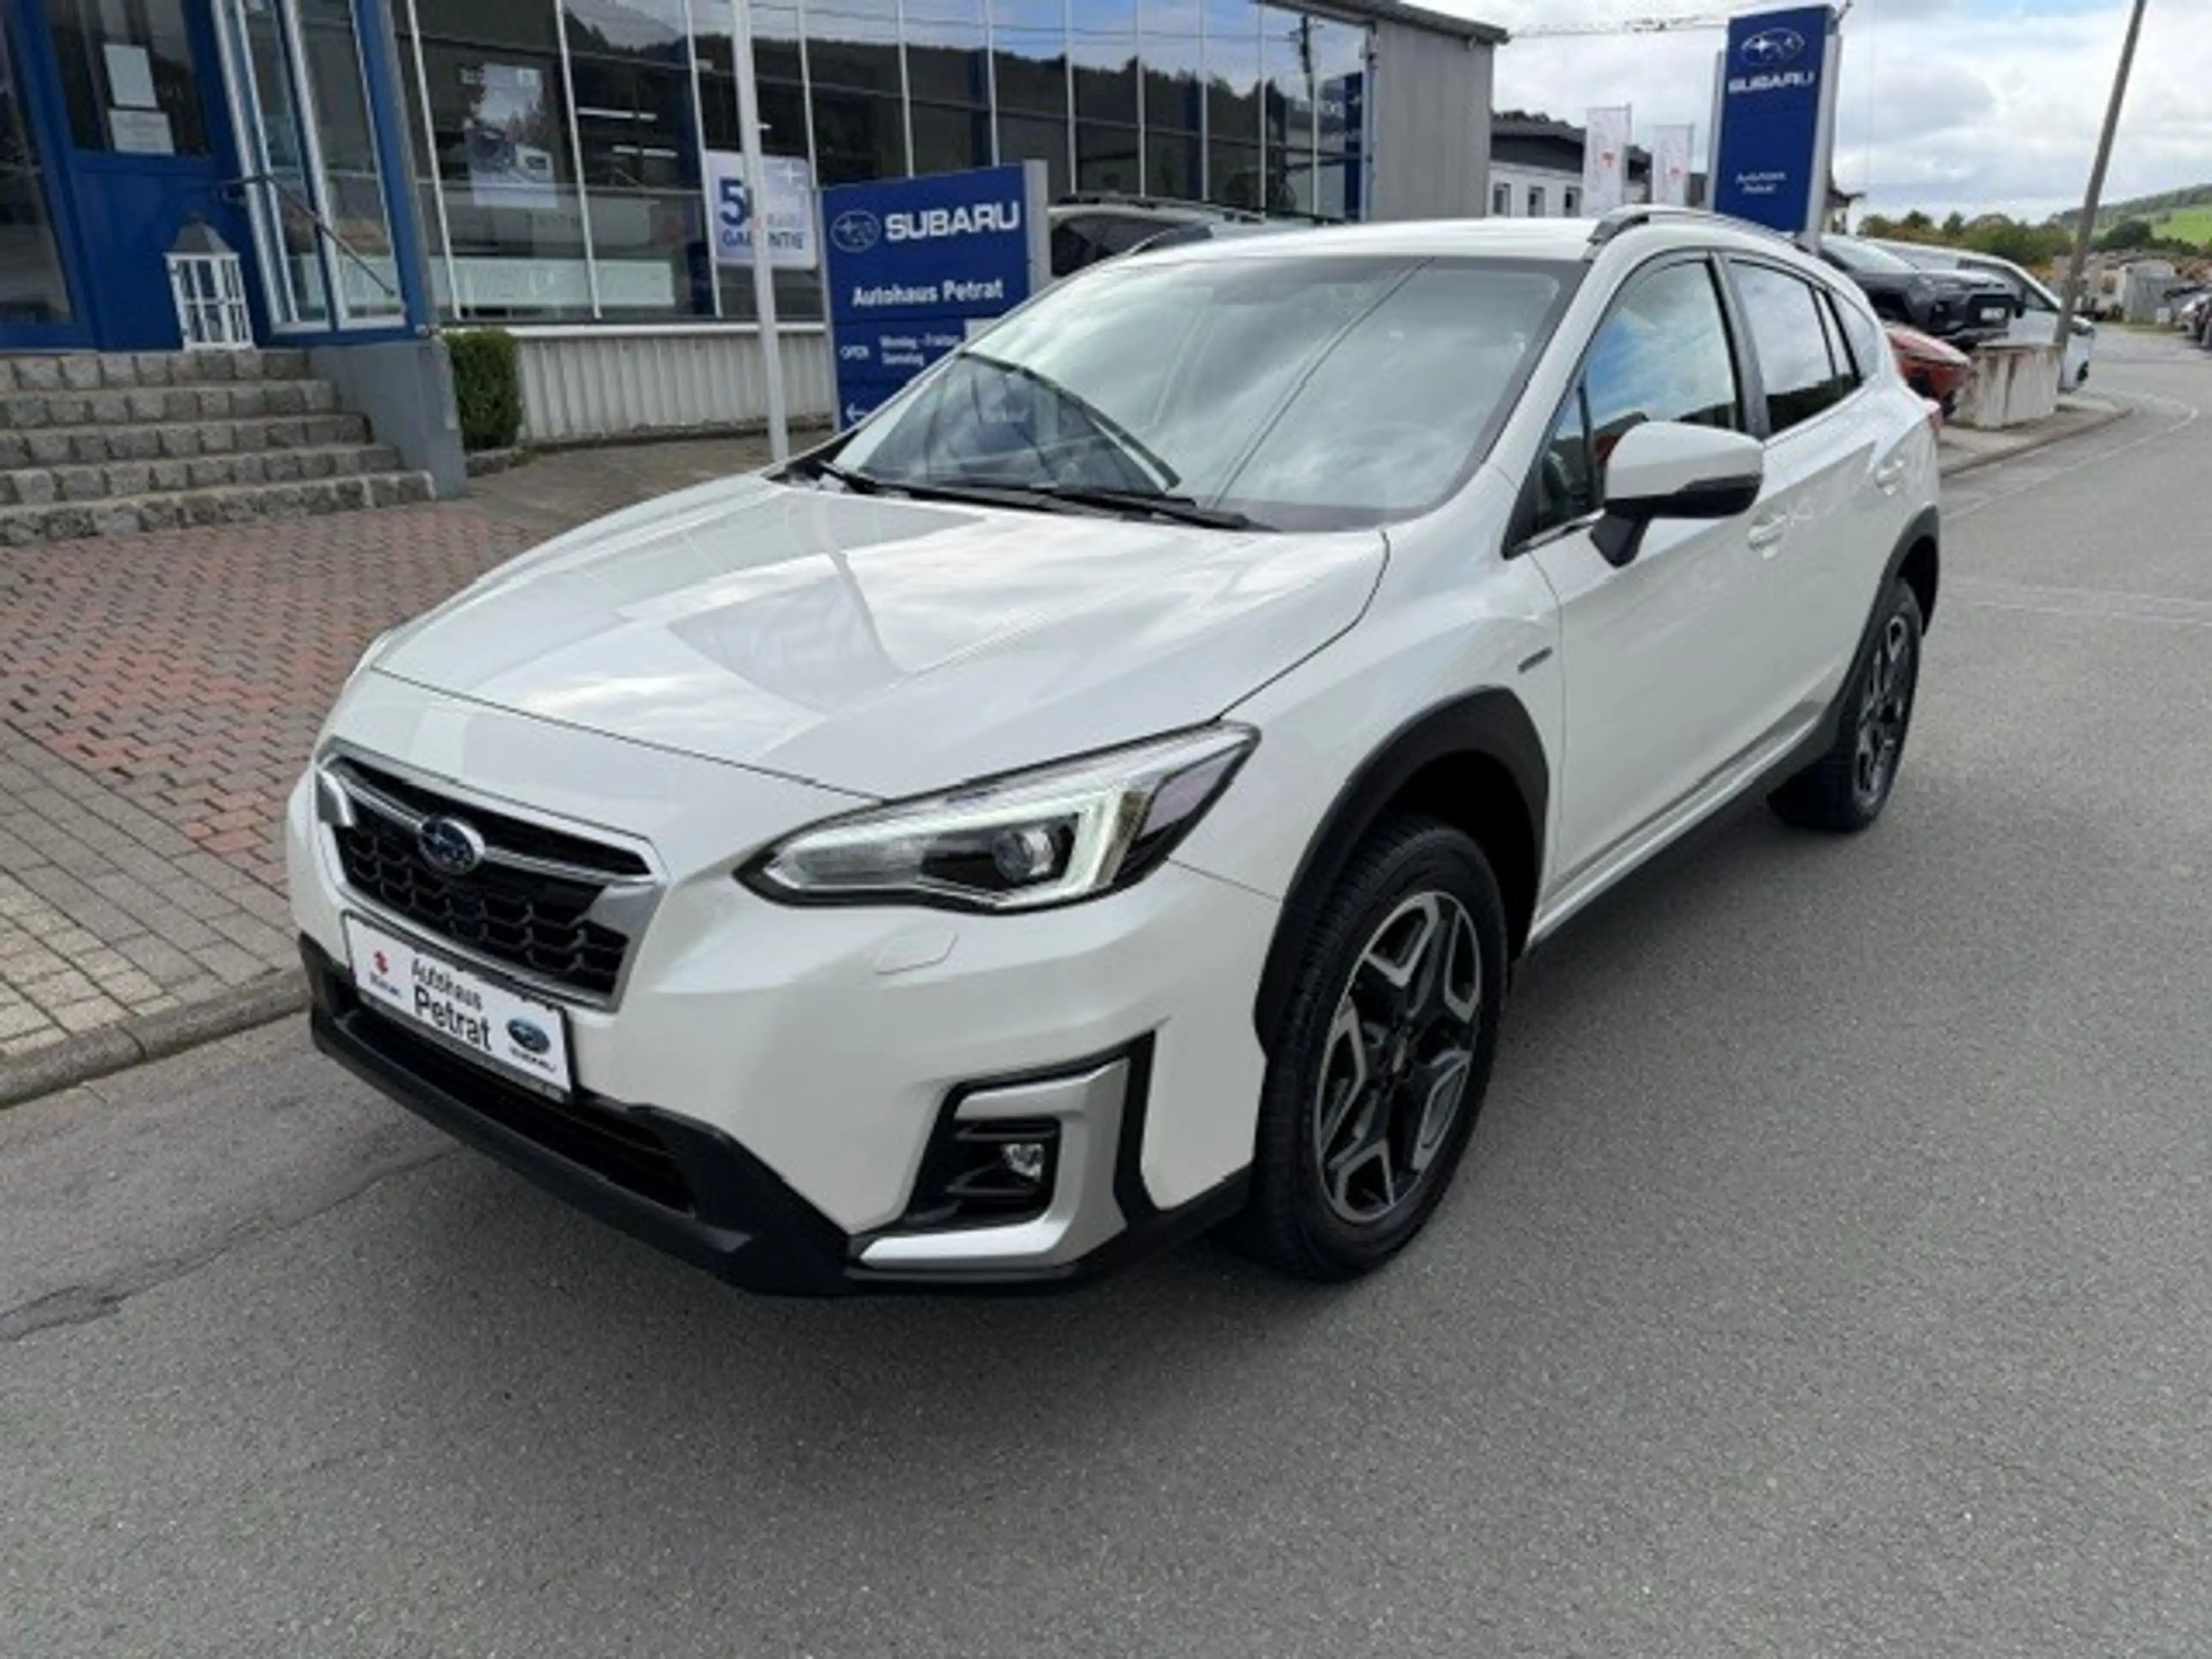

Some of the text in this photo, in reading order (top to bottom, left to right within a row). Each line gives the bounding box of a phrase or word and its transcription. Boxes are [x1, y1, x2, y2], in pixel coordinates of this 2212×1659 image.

[884, 201, 1020, 243] SUBARU
[852, 276, 1004, 307] Autohaus Petrat
[412, 958, 482, 1011] Autohaus
[415, 985, 492, 1052] Petrat
